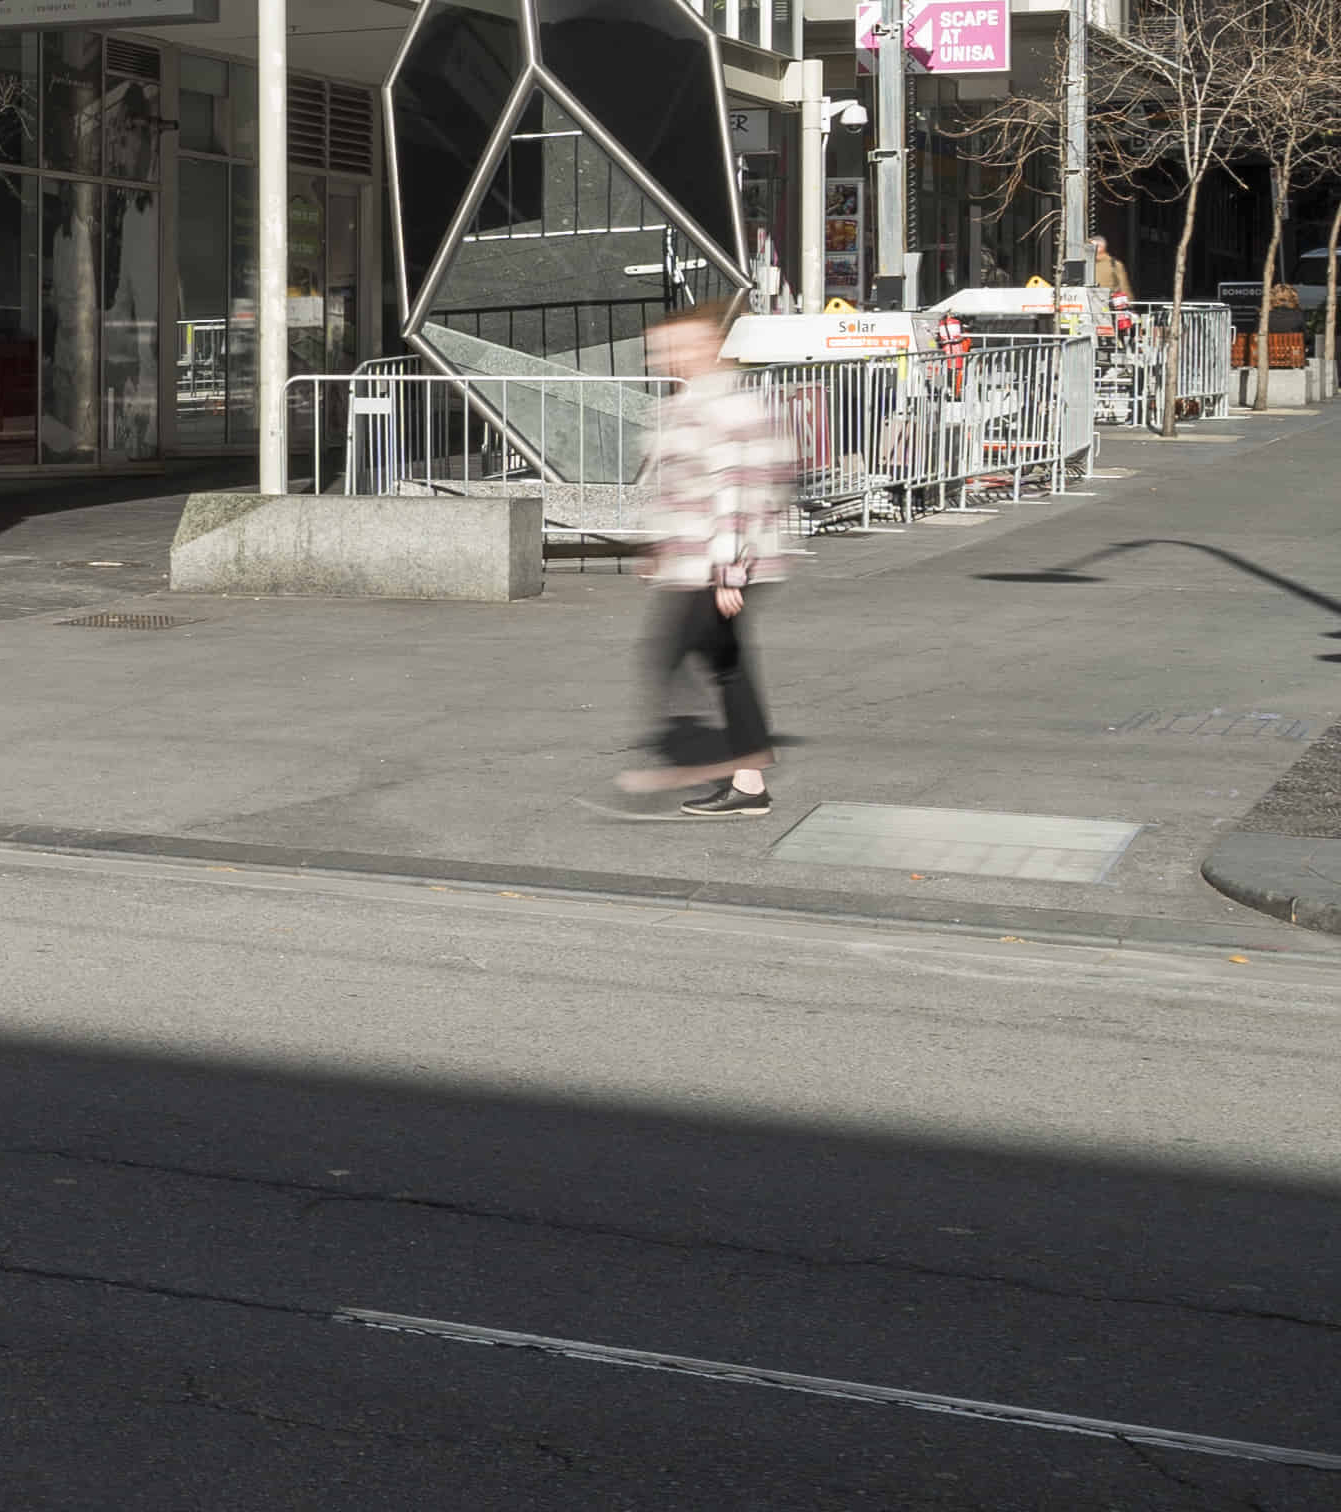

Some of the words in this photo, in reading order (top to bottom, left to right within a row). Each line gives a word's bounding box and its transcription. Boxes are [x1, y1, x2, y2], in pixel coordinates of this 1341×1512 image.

[940, 9, 998, 27] SCAPE
[940, 28, 962, 44] AT
[940, 44, 995, 63] UNISA
[838, 320, 876, 333] Solar
